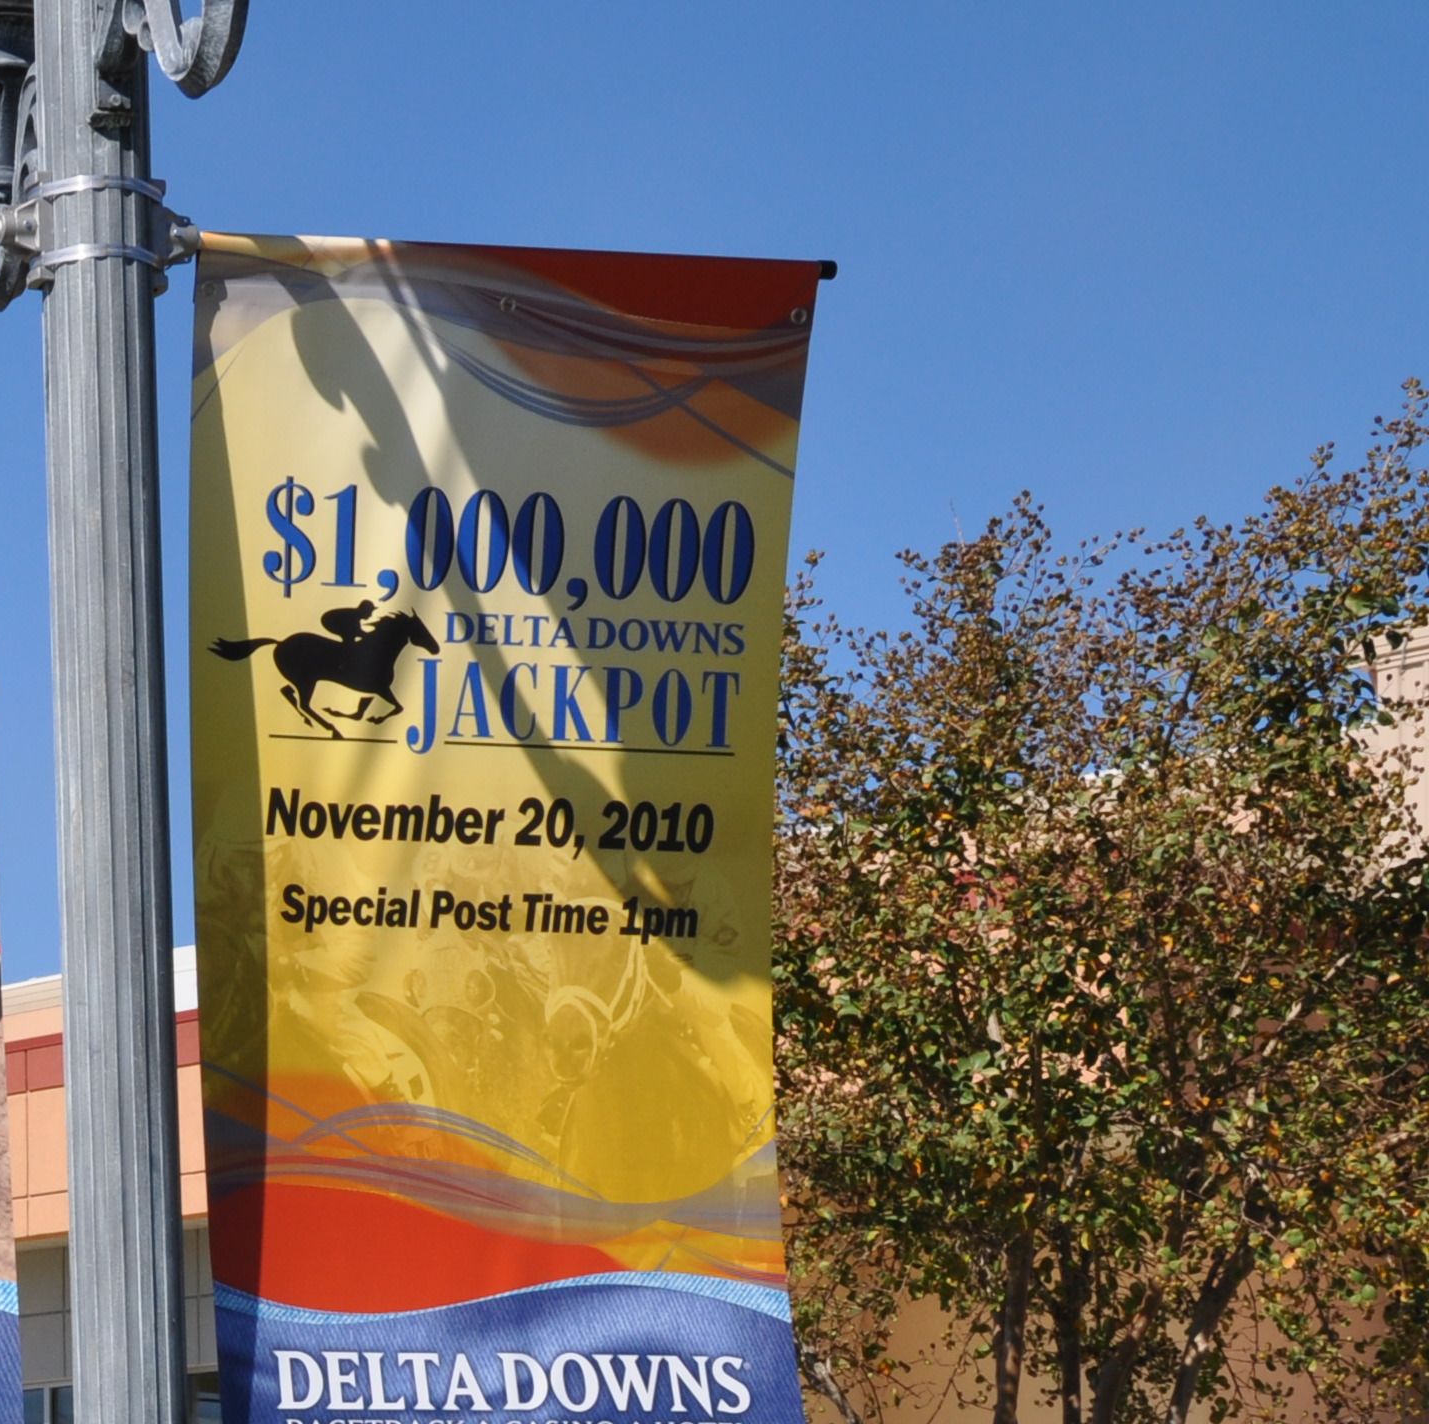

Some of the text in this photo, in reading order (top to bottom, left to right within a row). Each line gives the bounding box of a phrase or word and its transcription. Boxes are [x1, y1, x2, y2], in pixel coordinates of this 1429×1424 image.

[262, 475, 755, 611] $1,000,000
[446, 611, 746, 656] DELTA DOWNS
[405, 658, 741, 754] JACKPOT
[266, 787, 715, 860] November 20, 2010
[281, 884, 698, 946] Special Post Time 1pm
[273, 1350, 751, 1416] DELTA DOWNS
